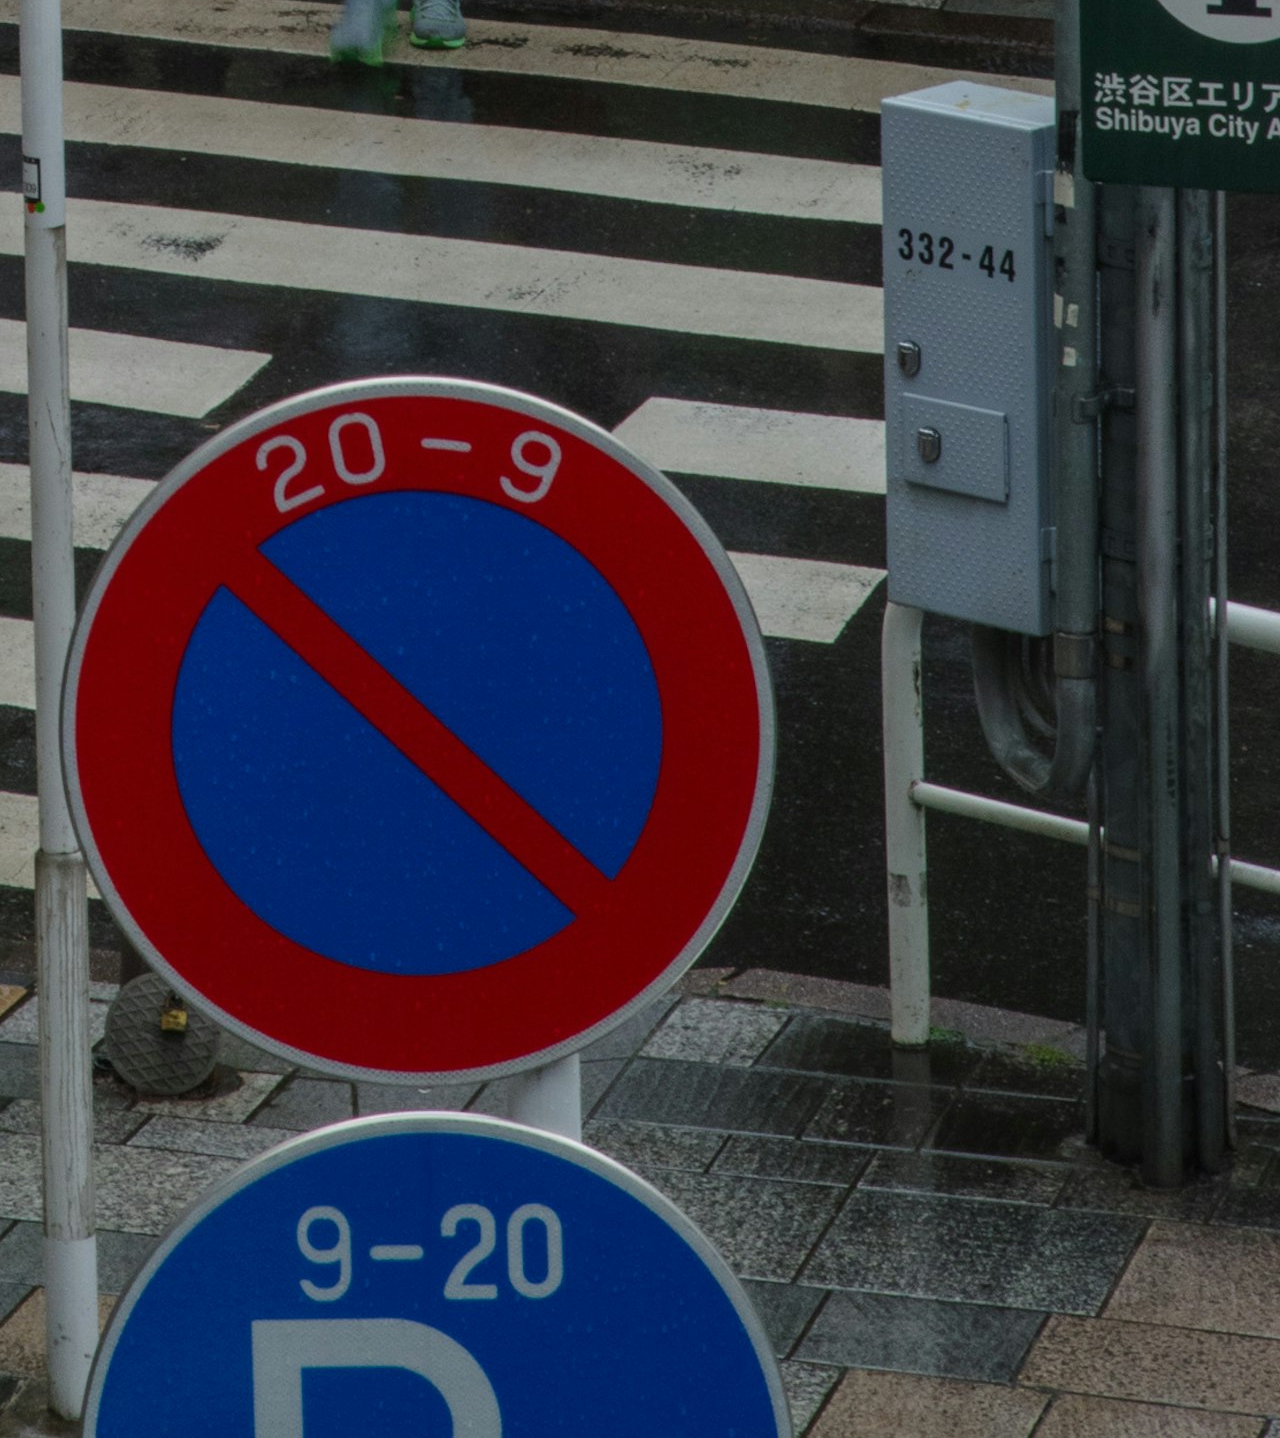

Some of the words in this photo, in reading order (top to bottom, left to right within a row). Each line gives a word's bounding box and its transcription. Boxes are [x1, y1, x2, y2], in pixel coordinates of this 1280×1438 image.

[1095, 106, 1201, 140] Shibuya
[1207, 113, 1259, 145] City
[898, 228, 1016, 283] 332-44
